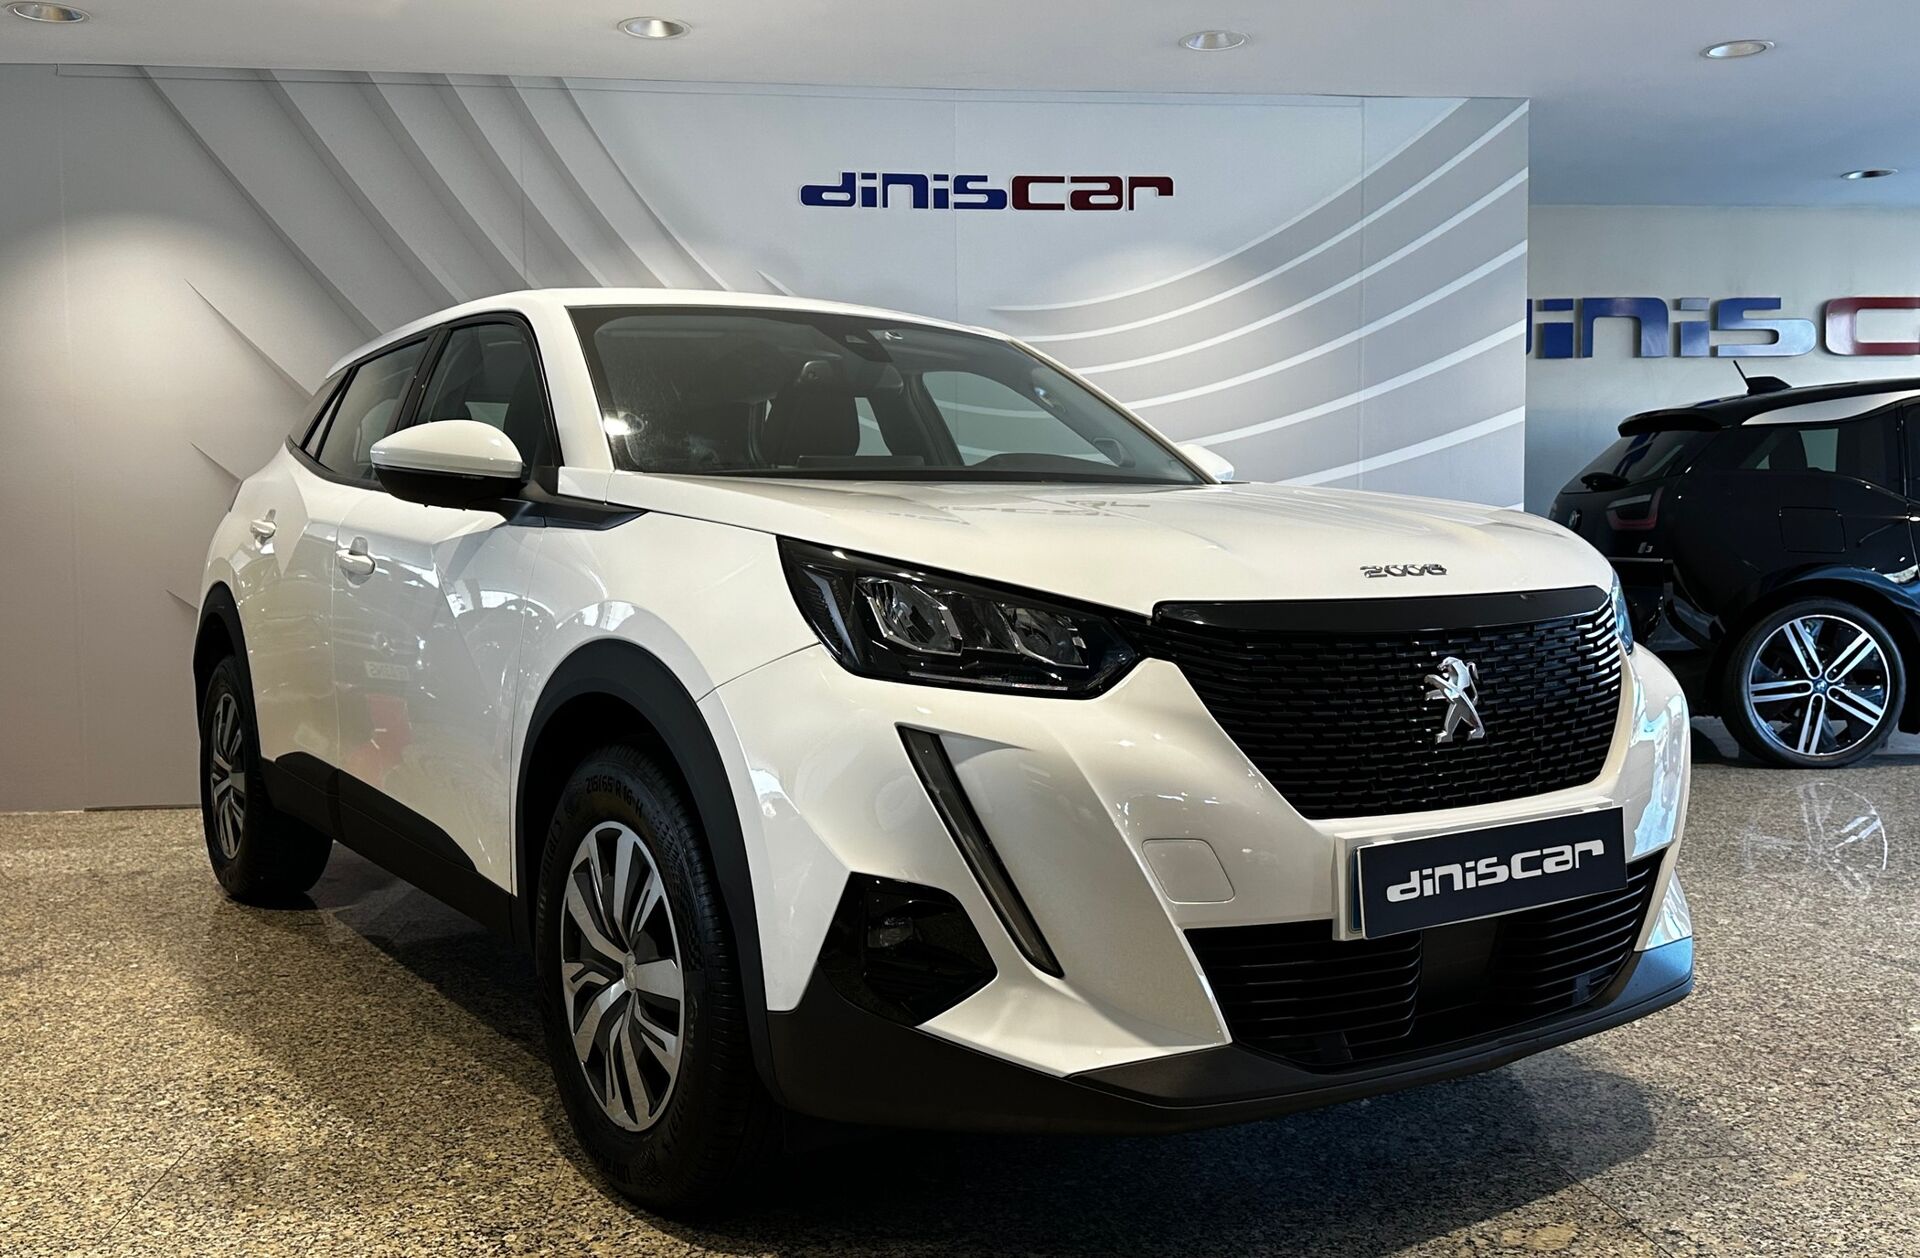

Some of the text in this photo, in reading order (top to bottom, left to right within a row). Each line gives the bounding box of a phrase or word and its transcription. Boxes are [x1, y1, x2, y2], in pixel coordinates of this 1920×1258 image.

[800, 171, 1174, 211] diniscar
[1527, 296, 1920, 359] inisc
[1360, 563, 1448, 579] 2008
[1386, 839, 1605, 903] diniscar
